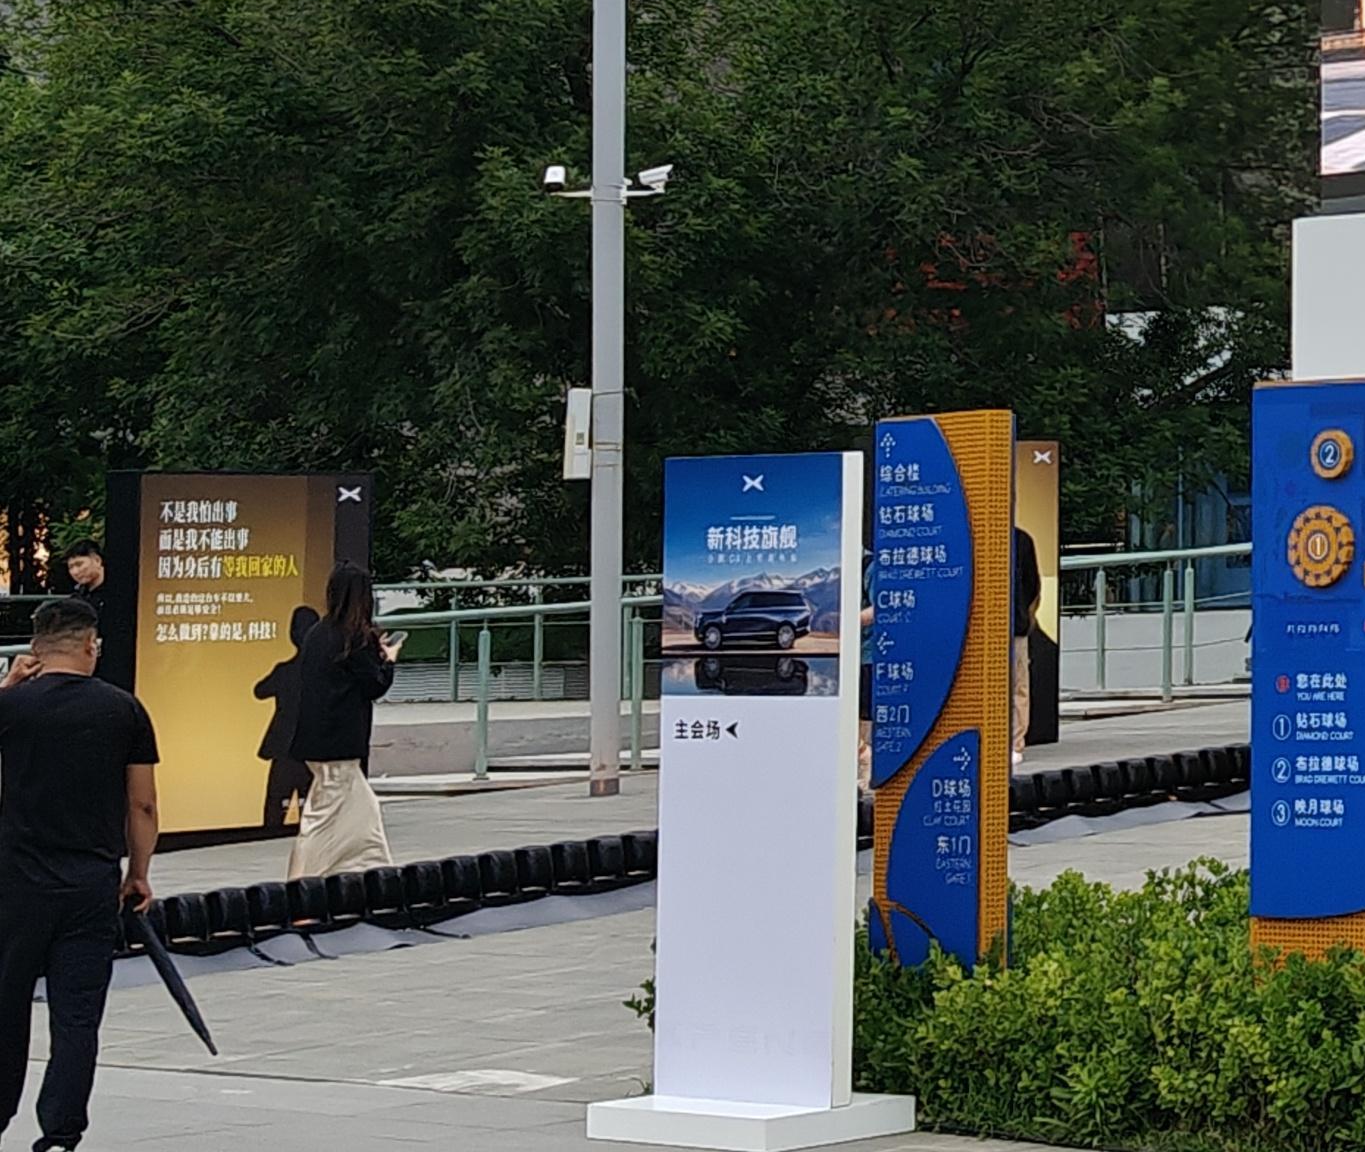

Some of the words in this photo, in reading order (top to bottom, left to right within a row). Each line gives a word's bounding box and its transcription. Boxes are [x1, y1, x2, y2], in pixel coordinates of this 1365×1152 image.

[880, 463, 920, 482] 综合楼
[160, 500, 237, 523] 不是我怕出事
[879, 503, 934, 524] 钻石球场
[159, 528, 249, 551] 而是我不能出事
[706, 525, 797, 550] 新科技旗舰
[879, 544, 946, 565] 布拉德球场
[158, 555, 298, 579] 因为身后有等我回家的人
[877, 589, 916, 609] C球场
[875, 662, 913, 681] F球场
[1296, 672, 1347, 689] 您在此处
[1297, 692, 1311, 701] YOU
[1312, 692, 1326, 701] ARE
[1327, 691, 1344, 701] HERE
[875, 705, 909, 723] 西2门
[1296, 712, 1347, 728] 钻石球场
[674, 719, 720, 740] 主会场
[1330, 731, 1354, 740] COURT
[1295, 756, 1359, 772] 布拉德球场
[932, 779, 971, 798] D球场
[1295, 799, 1344, 815] 映月球场
[1320, 818, 1343, 827] COURT
[936, 835, 971, 855] 东1门
